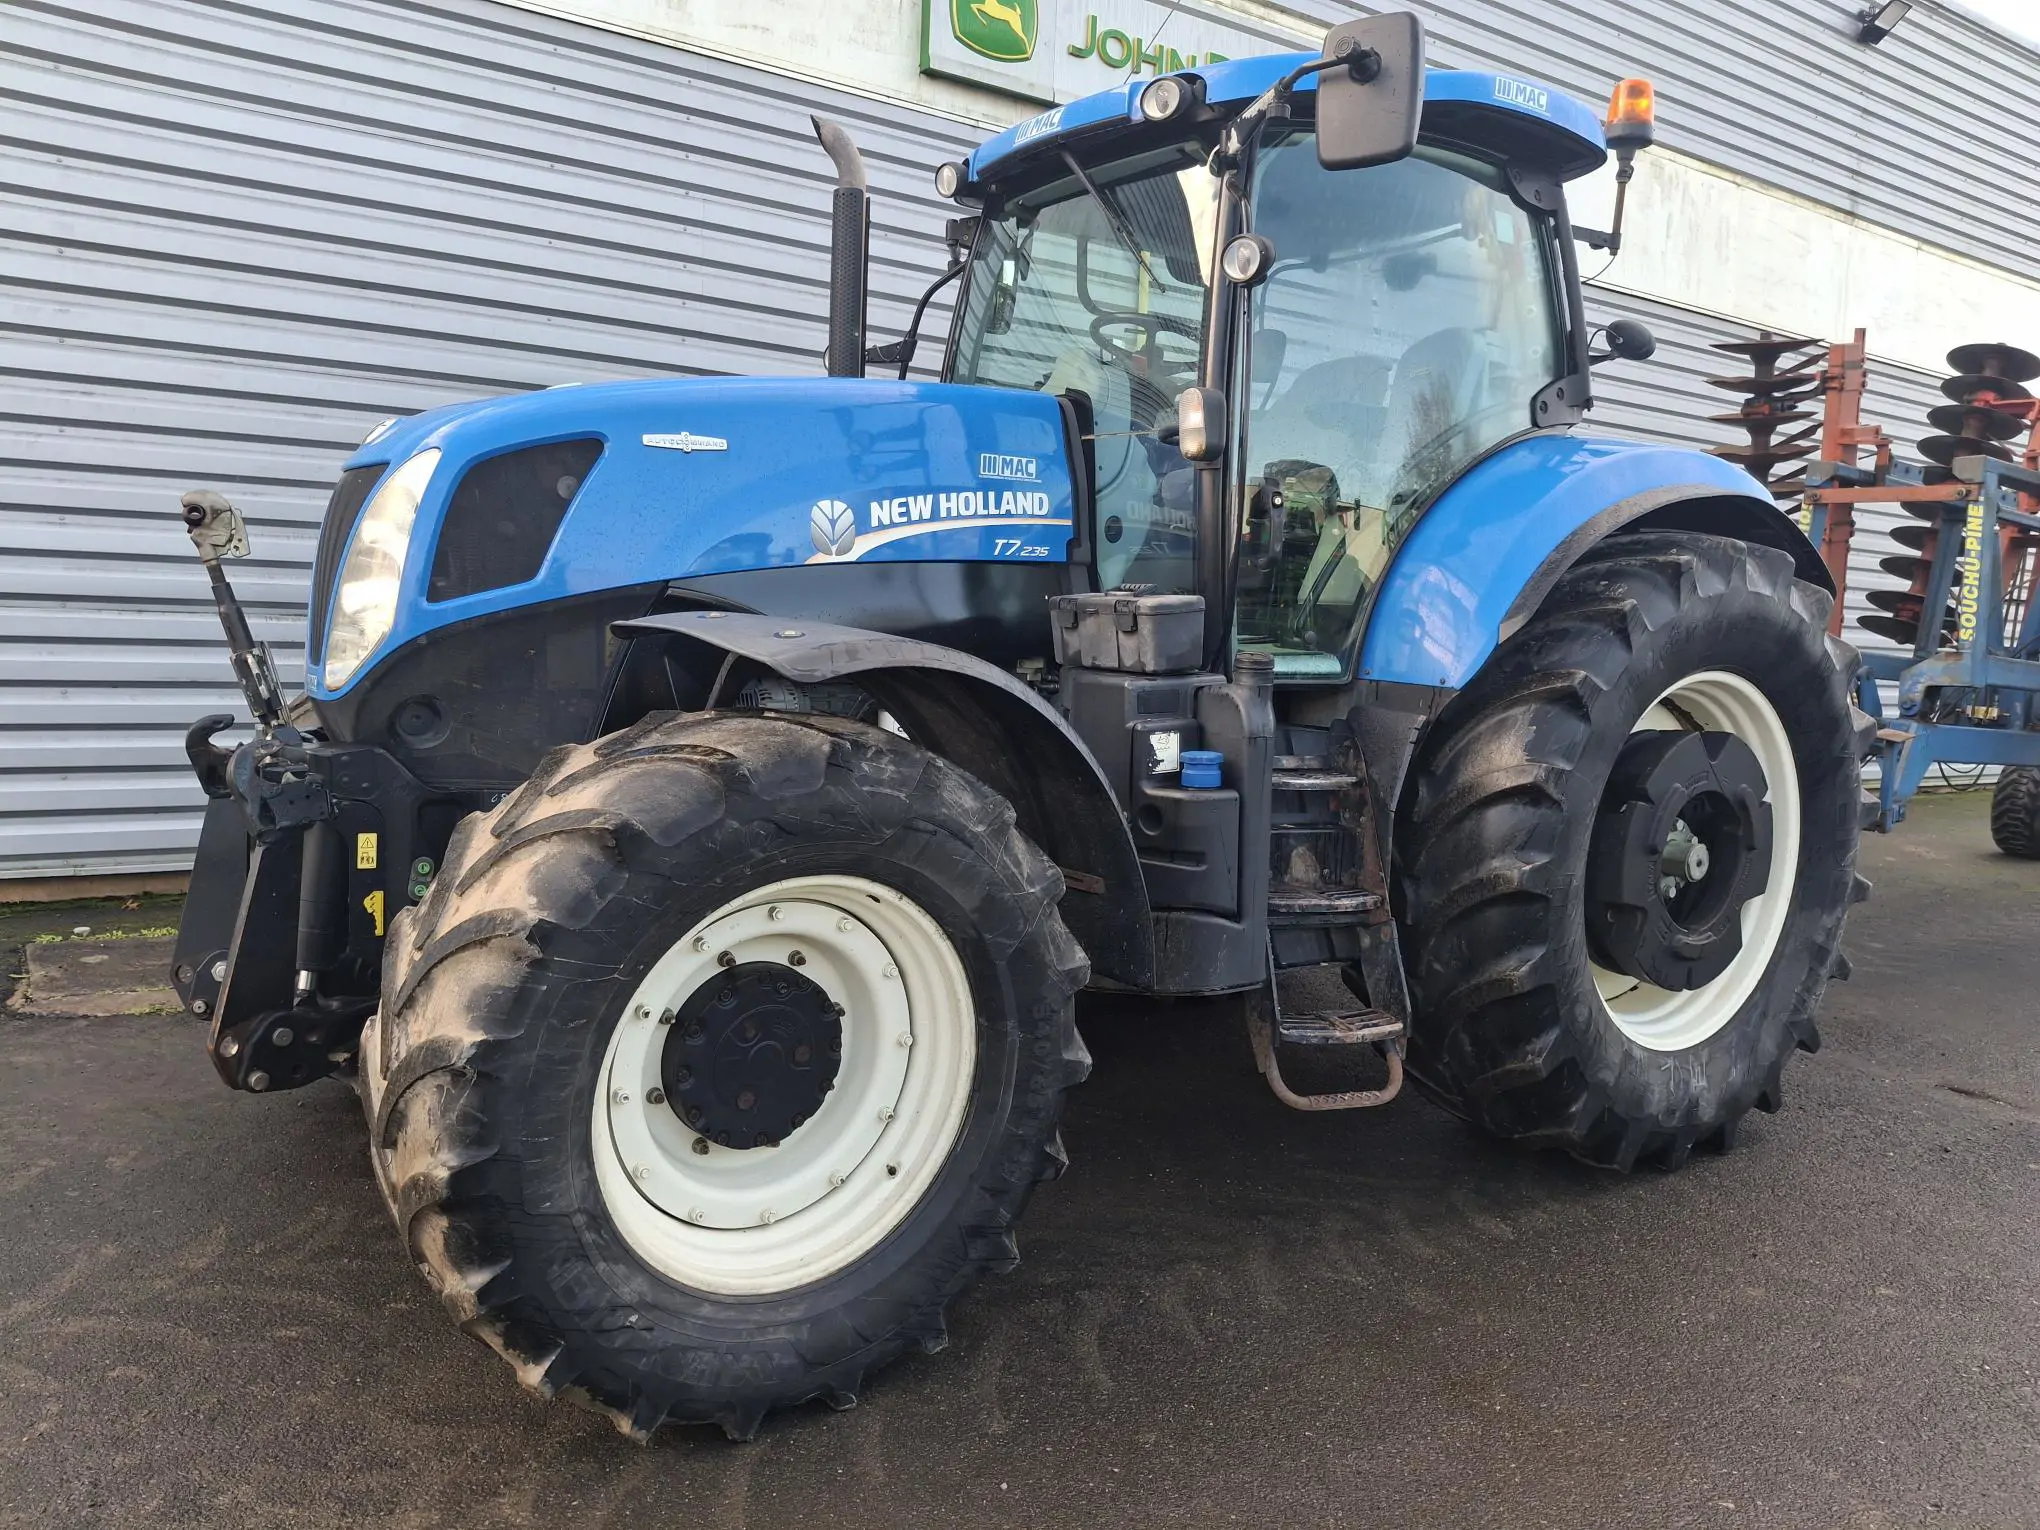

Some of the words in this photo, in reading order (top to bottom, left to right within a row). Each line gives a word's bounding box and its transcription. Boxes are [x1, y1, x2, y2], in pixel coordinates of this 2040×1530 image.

[1068, 14, 1198, 75] JOHN
[1001, 457, 1035, 478] MAC
[870, 494, 934, 527] NEW
[940, 491, 1049, 517] HOLLAND
[1959, 496, 1985, 641] SOUCHU-PINE
